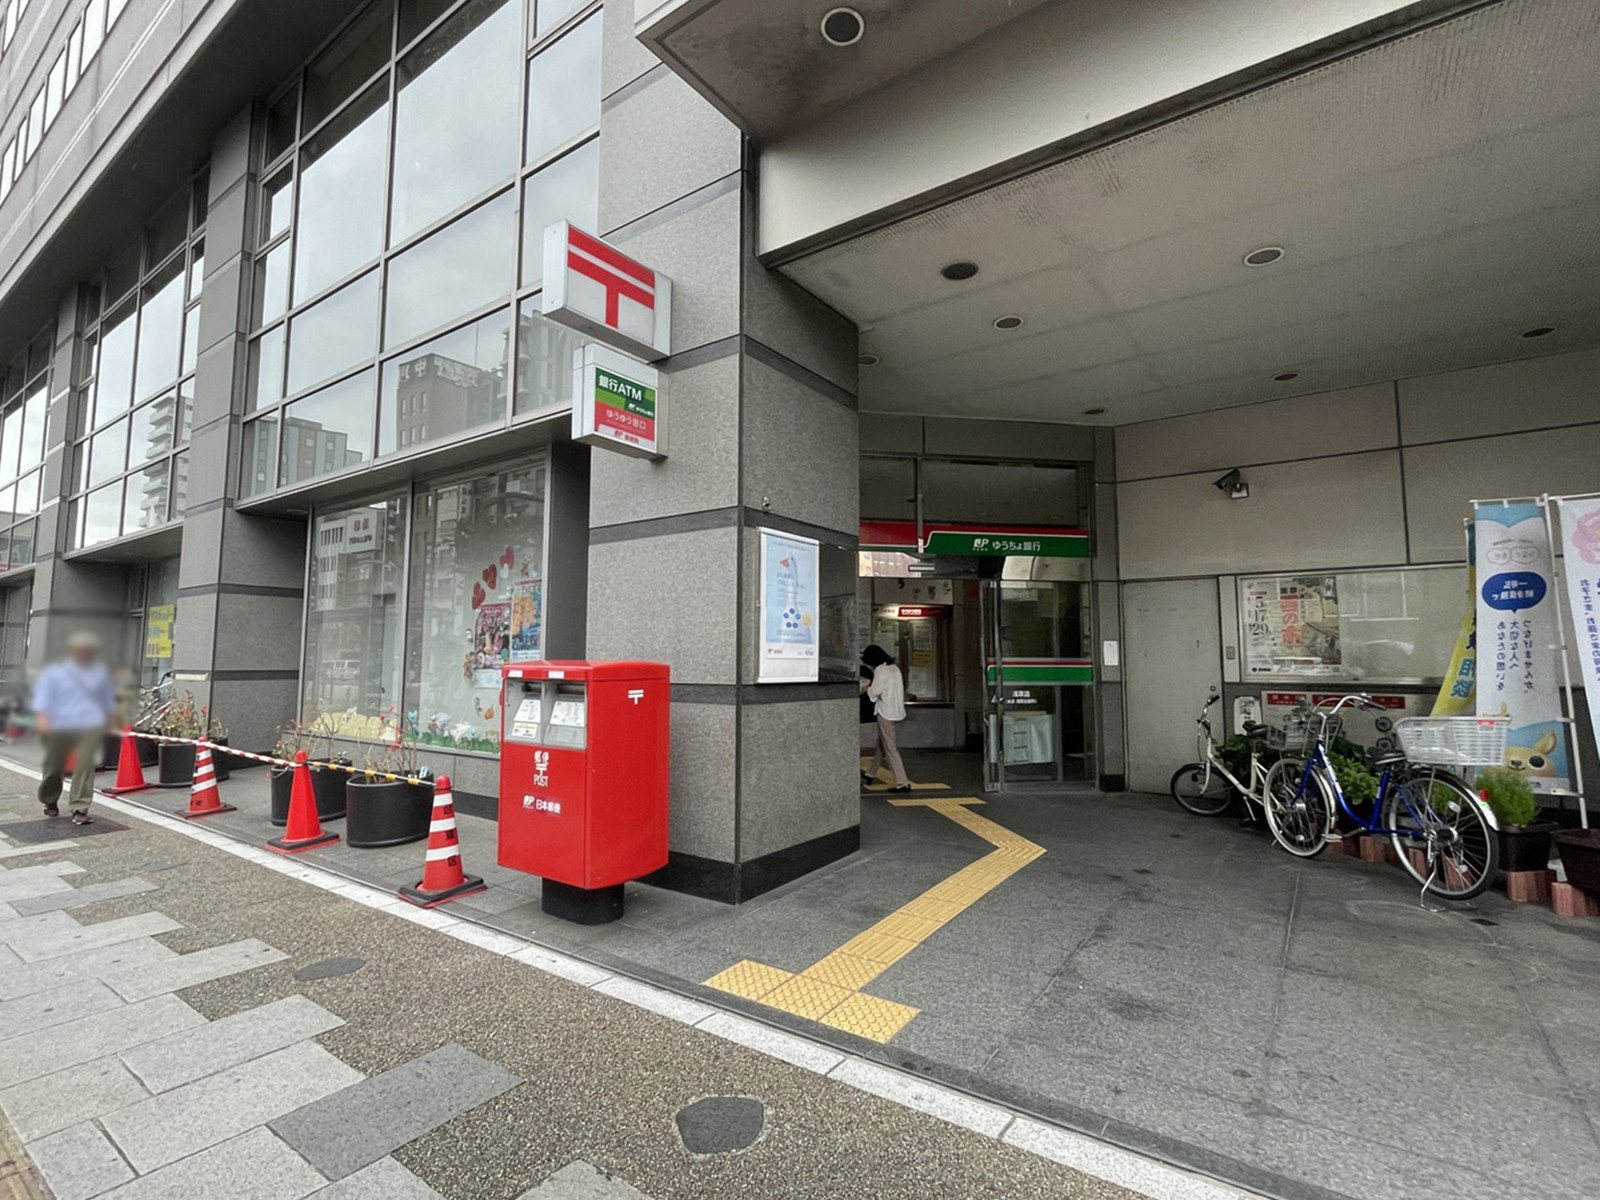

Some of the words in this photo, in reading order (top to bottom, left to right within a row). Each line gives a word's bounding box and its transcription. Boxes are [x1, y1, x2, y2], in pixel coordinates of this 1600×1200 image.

[599, 375, 642, 401] 銀行ATM
[606, 410, 646, 430] ゆうゆう窓口
[992, 541, 1041, 551] ゆうちょ銀行
[534, 774, 549, 788] POST
[536, 800, 561, 814] 日本郵便
